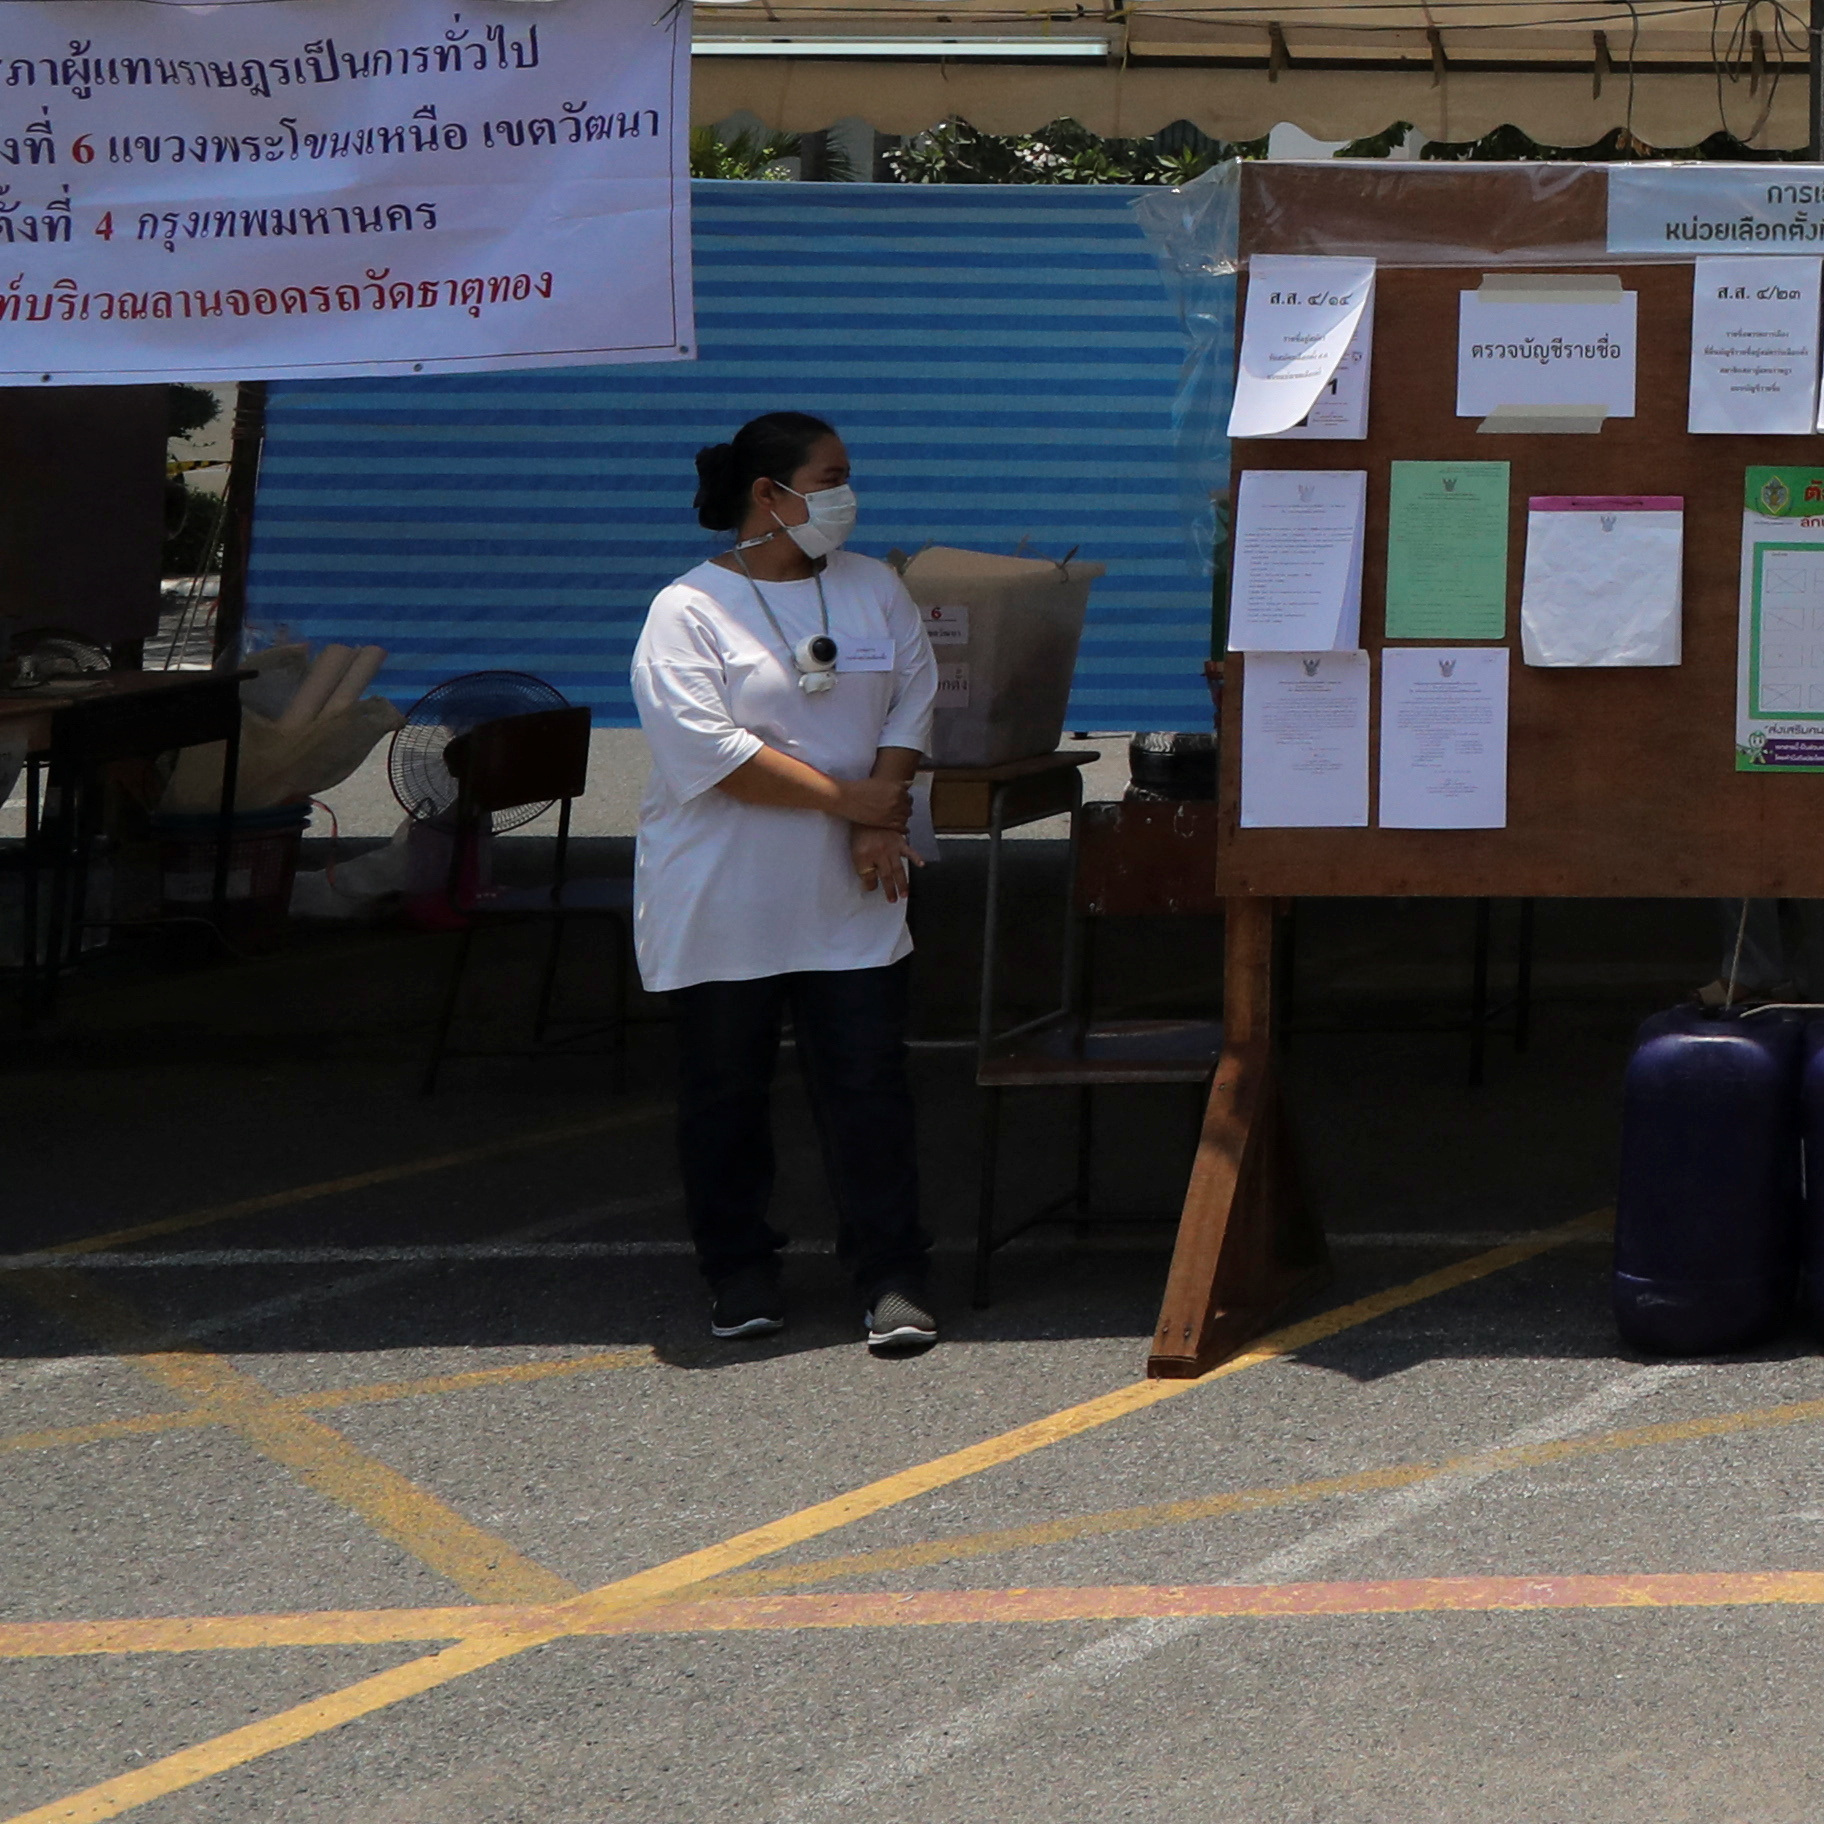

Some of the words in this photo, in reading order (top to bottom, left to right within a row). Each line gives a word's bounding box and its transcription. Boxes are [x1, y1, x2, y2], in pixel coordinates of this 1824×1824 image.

[0, 14, 540, 99] ภาผู้แทนราษฎรเป็นการทั่วไป
[71, 133, 95, 164] 6
[108, 104, 468, 165] แขวงพระโขนงเหนือ
[483, 101, 660, 150] เขตวัฒนา
[94, 210, 114, 241] 4
[137, 198, 438, 252] กรุงเทพมหานคร
[1270, 291, 1301, 306] ส.ส.
[1718, 286, 1750, 299] ส.ส.
[1757, 285, 1801, 299] ๔/๒๓
[1471, 334, 1621, 364] ตรวจบัญชีรายชื่อ
[932, 607, 941, 618] 6
